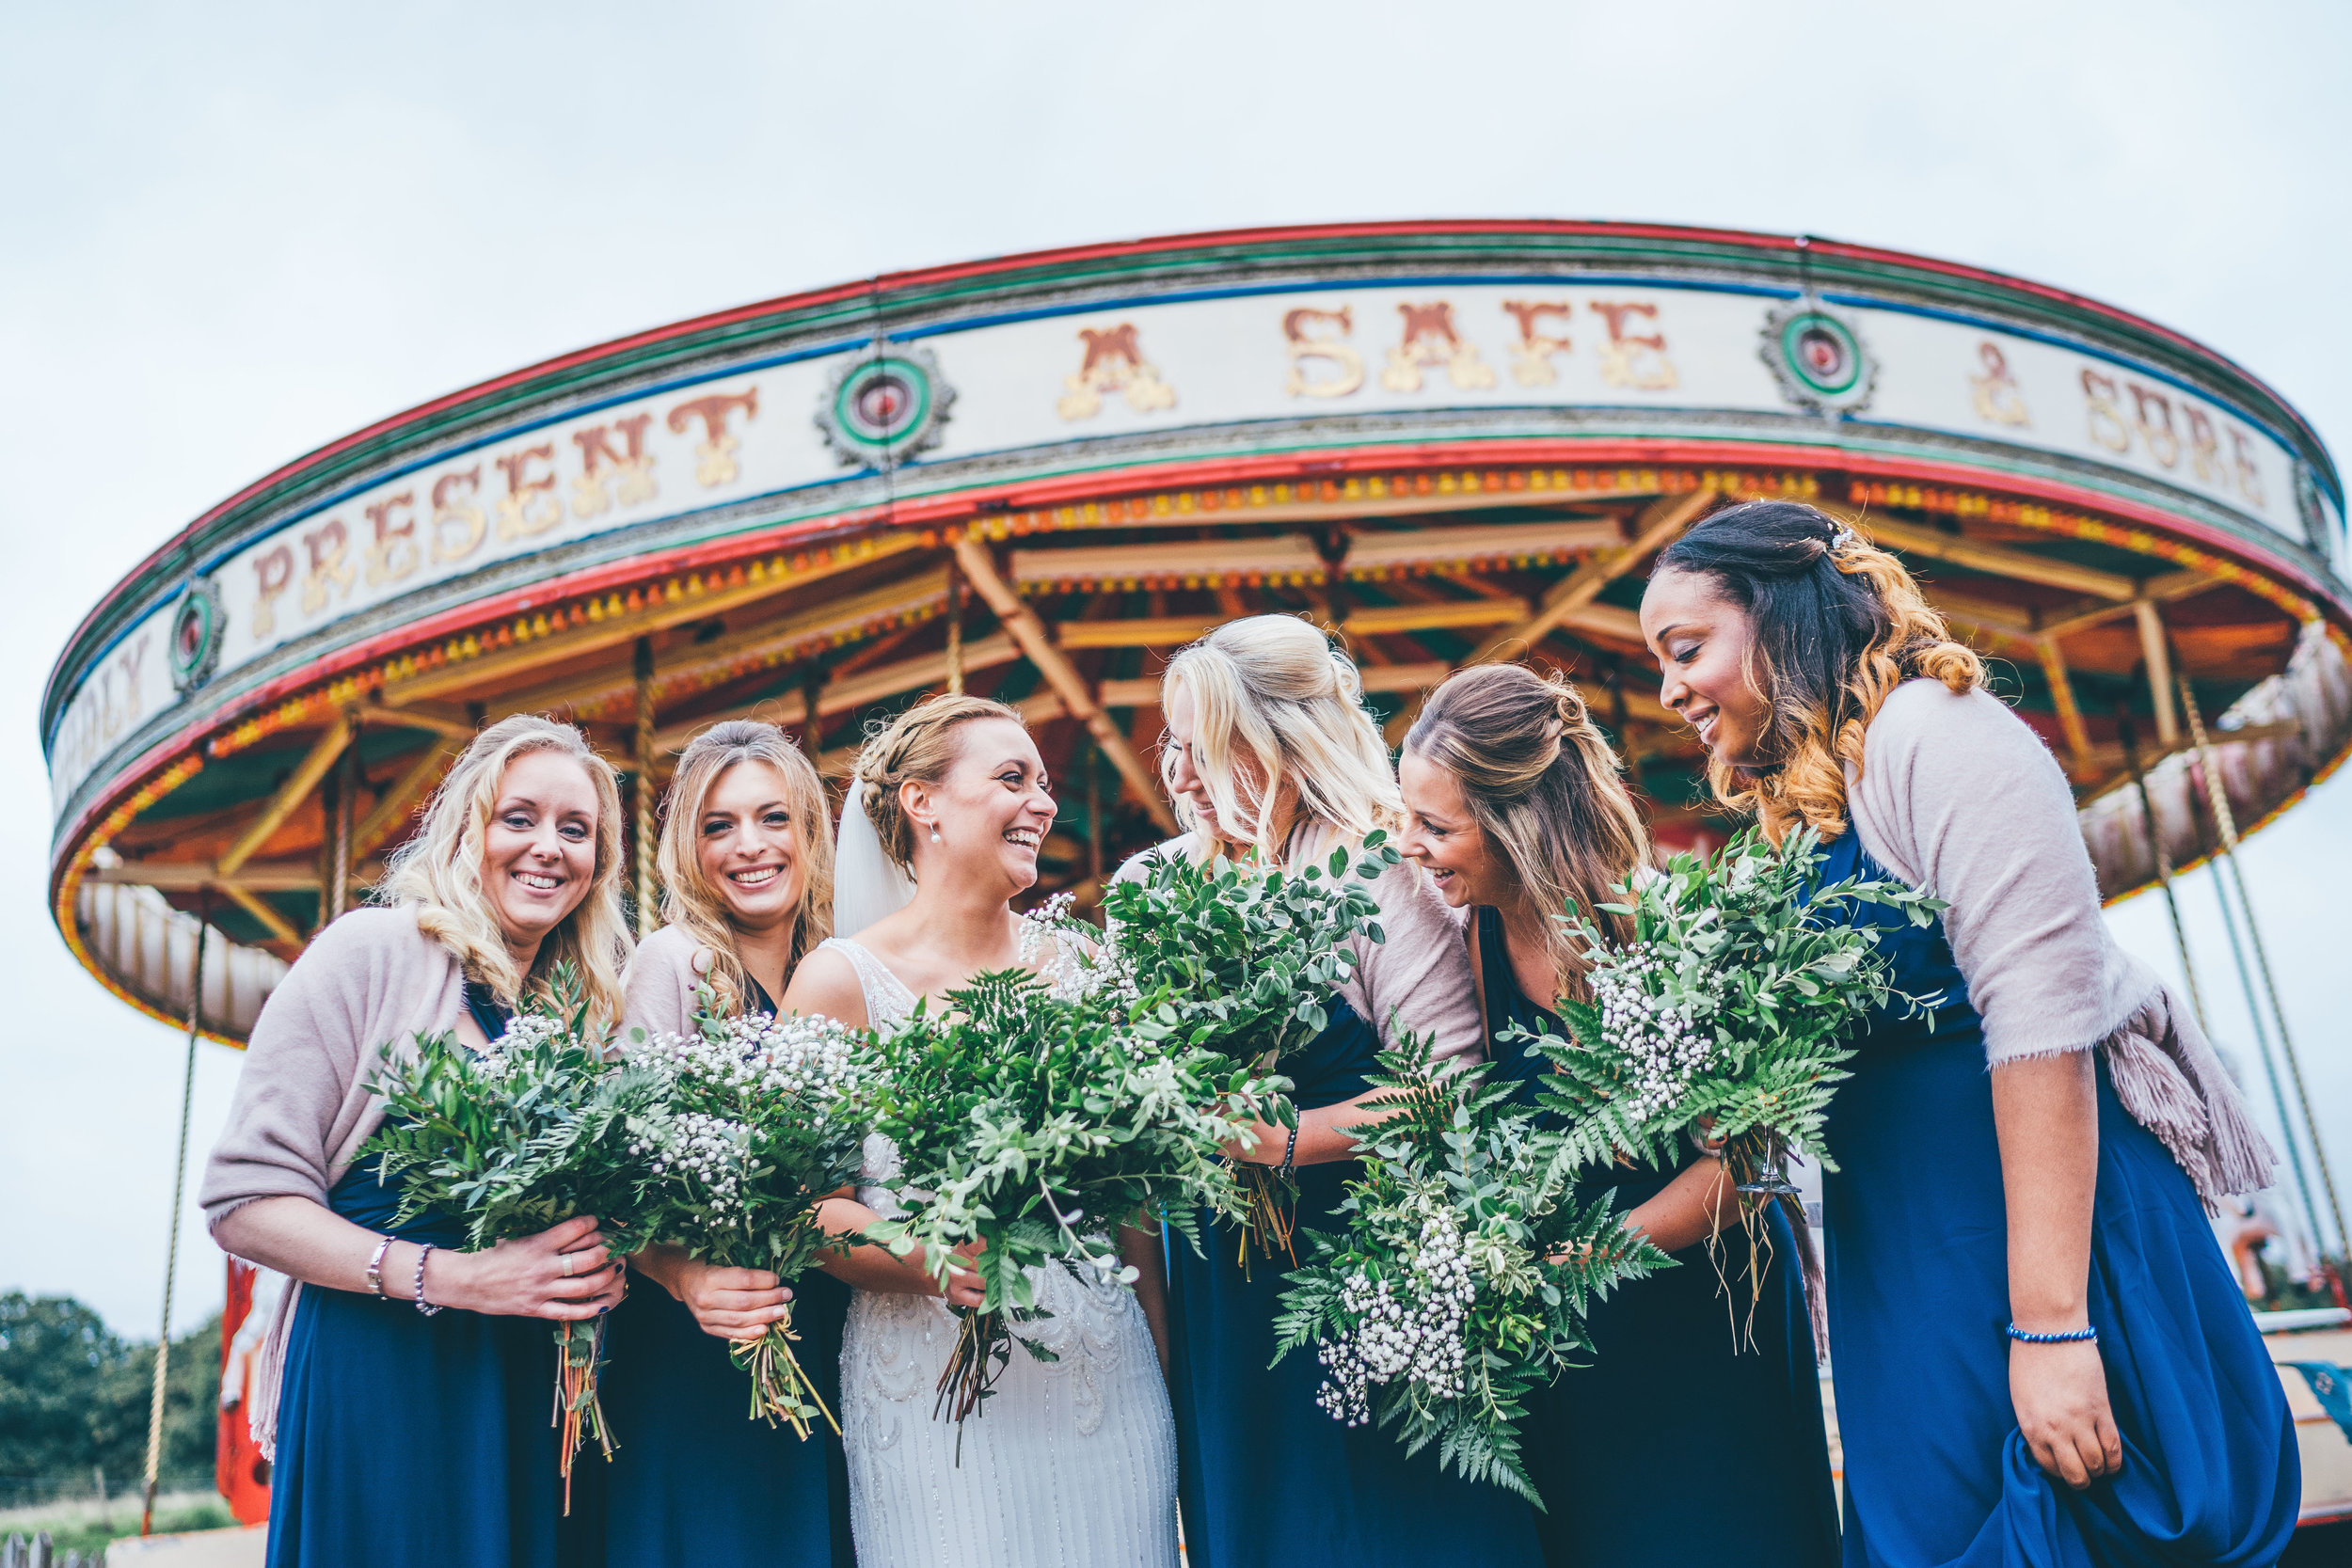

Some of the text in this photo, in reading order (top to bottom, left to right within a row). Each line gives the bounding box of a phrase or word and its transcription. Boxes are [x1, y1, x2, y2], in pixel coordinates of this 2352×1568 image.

[252, 386, 759, 639] PRESENT
[1057, 324, 1176, 421] A
[1281, 301, 1677, 398] SAFE
[1969, 342, 2032, 427] &
[2080, 368, 2265, 508] SURE
